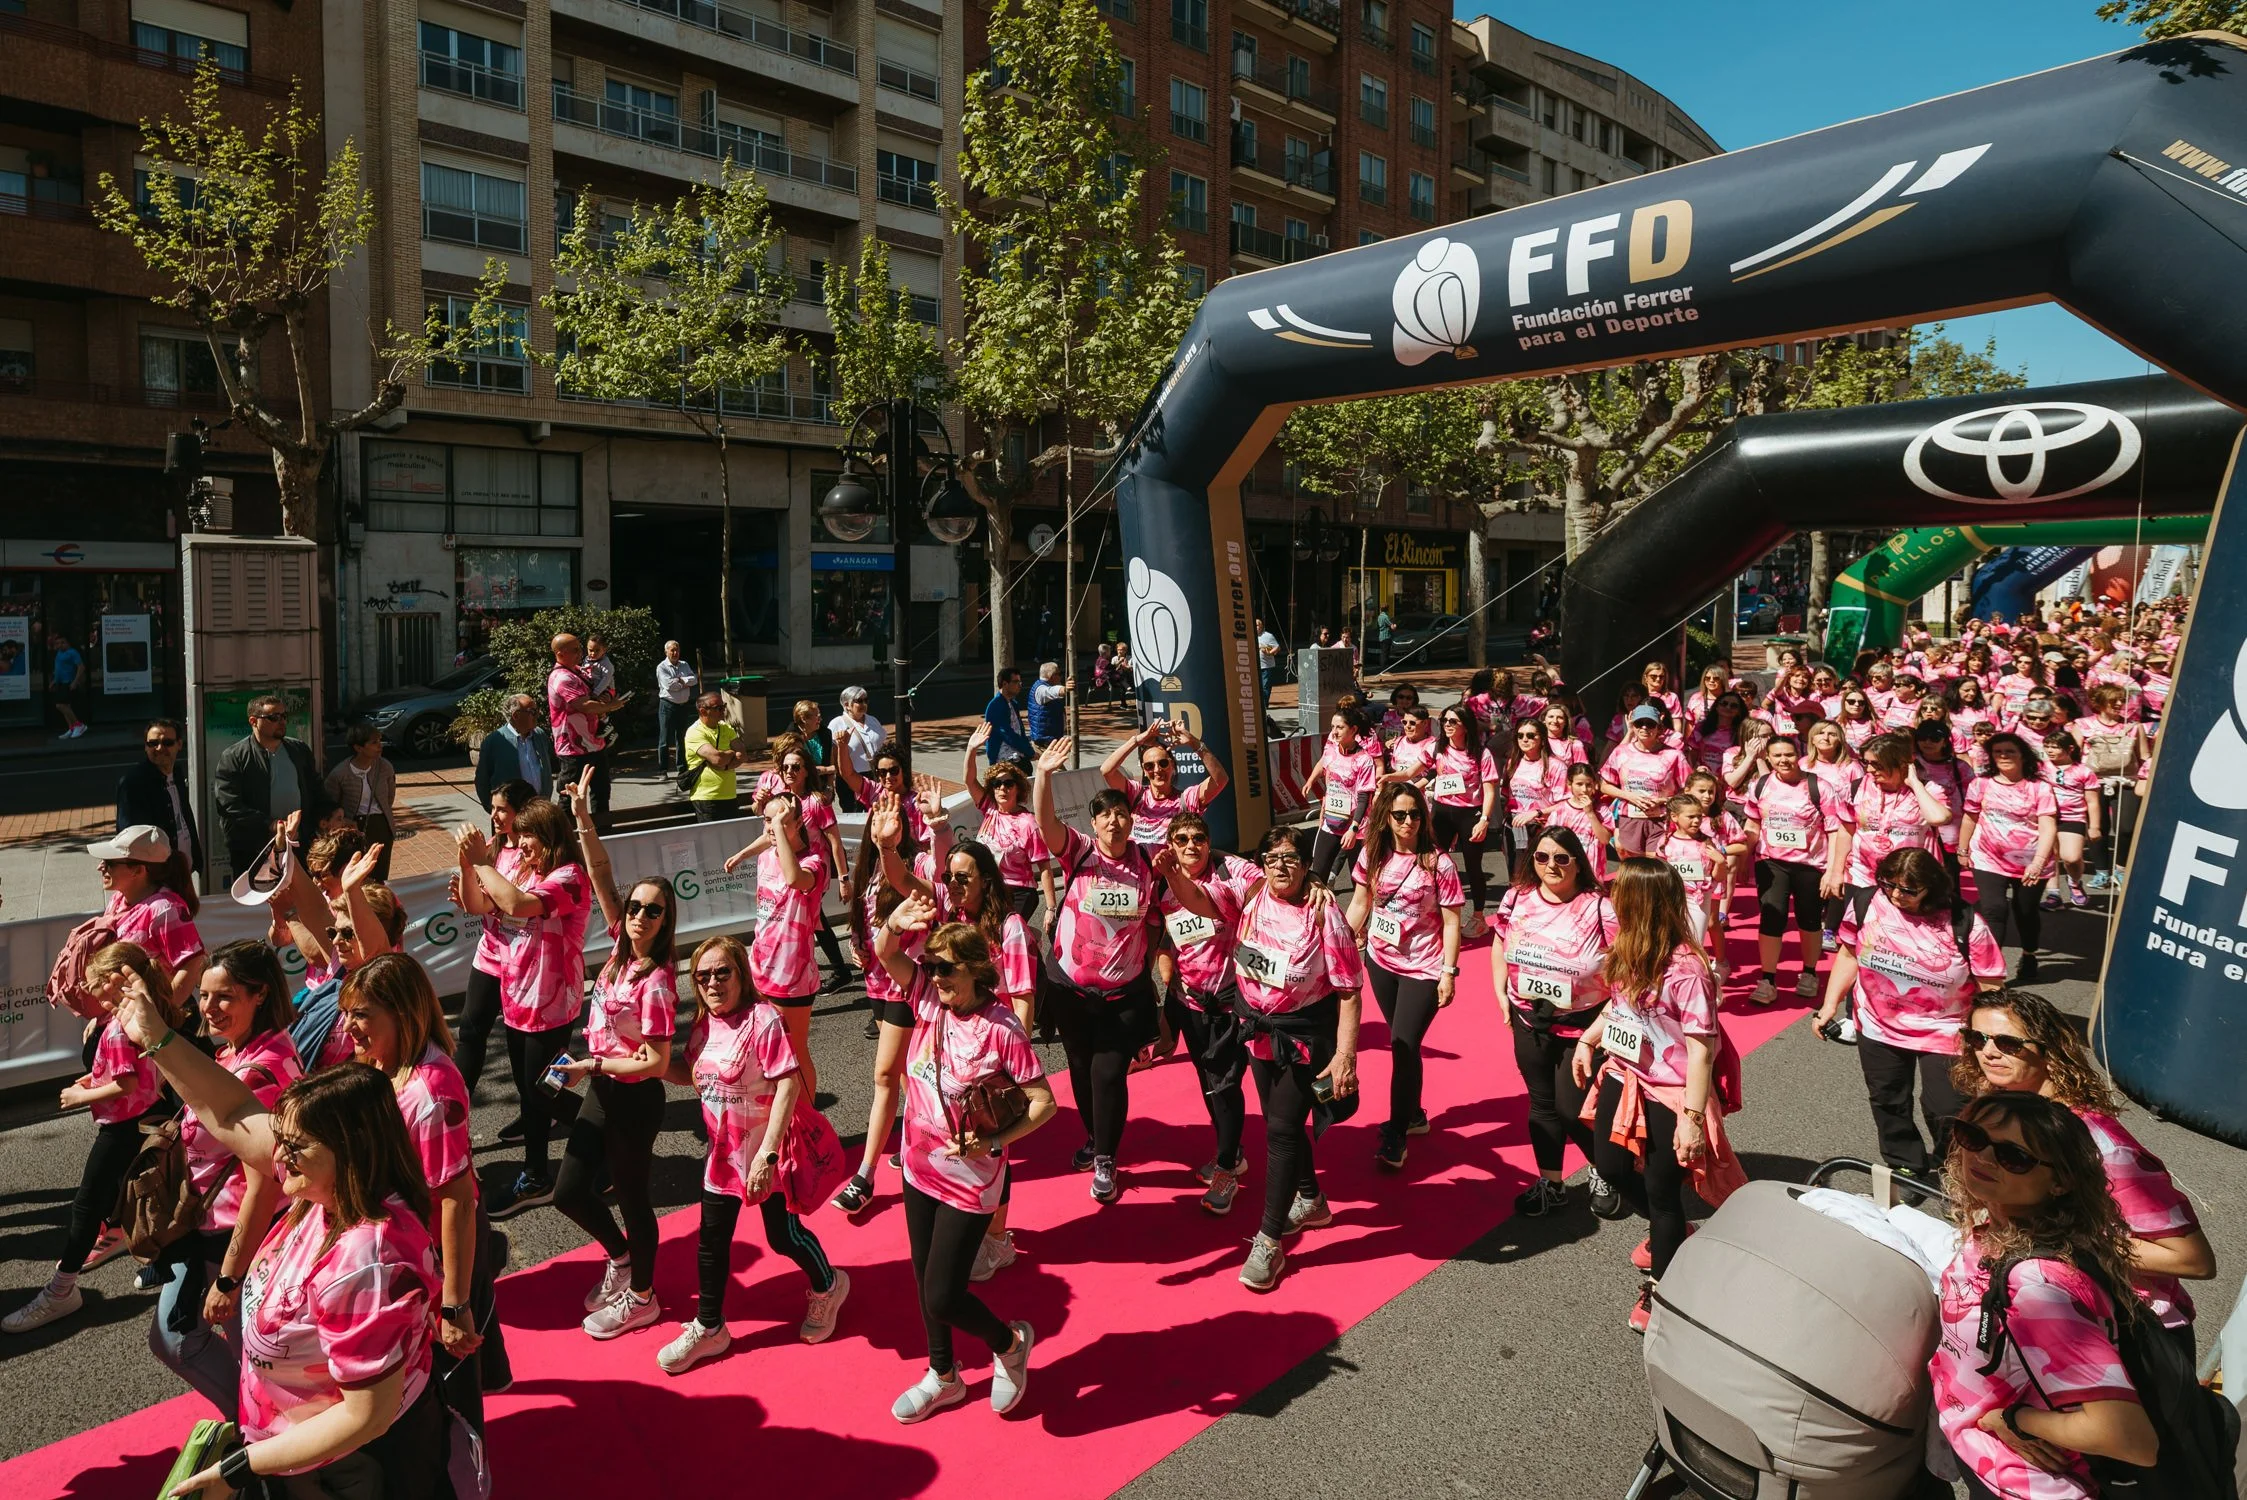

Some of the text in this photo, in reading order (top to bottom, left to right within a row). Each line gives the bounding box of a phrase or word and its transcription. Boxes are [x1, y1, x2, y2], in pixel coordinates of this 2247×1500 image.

[1508, 199, 1693, 308] FFD
[1512, 285, 1694, 331] Fundación Ferrer
[1518, 307, 1699, 350] para el Deporte
[1384, 532, 1446, 566] El Rincón
[1227, 541, 1262, 798] www.fundacionferrer.org
[1443, 779, 1457, 790] 254
[1330, 798, 1343, 809] 333
[1775, 831, 1797, 843] 963
[1100, 892, 1130, 907] 2313
[464, 918, 483, 929] cont
[1176, 916, 1205, 936] 2312
[1375, 916, 1396, 936] 7835
[1515, 948, 1531, 958] por
[1518, 938, 1554, 953] Carrera
[1873, 945, 1915, 962] Carrera
[2146, 931, 2207, 969] para
[1247, 953, 1277, 975] 2311
[1514, 956, 1580, 977] Investigación
[1870, 954, 1902, 969] por la
[1870, 962, 1945, 989] Investigación
[1526, 979, 1562, 998] 7836
[1608, 1025, 1637, 1050] 11208
[695, 1071, 718, 1081] Carrera
[1979, 1312, 1989, 1344] Quechua
